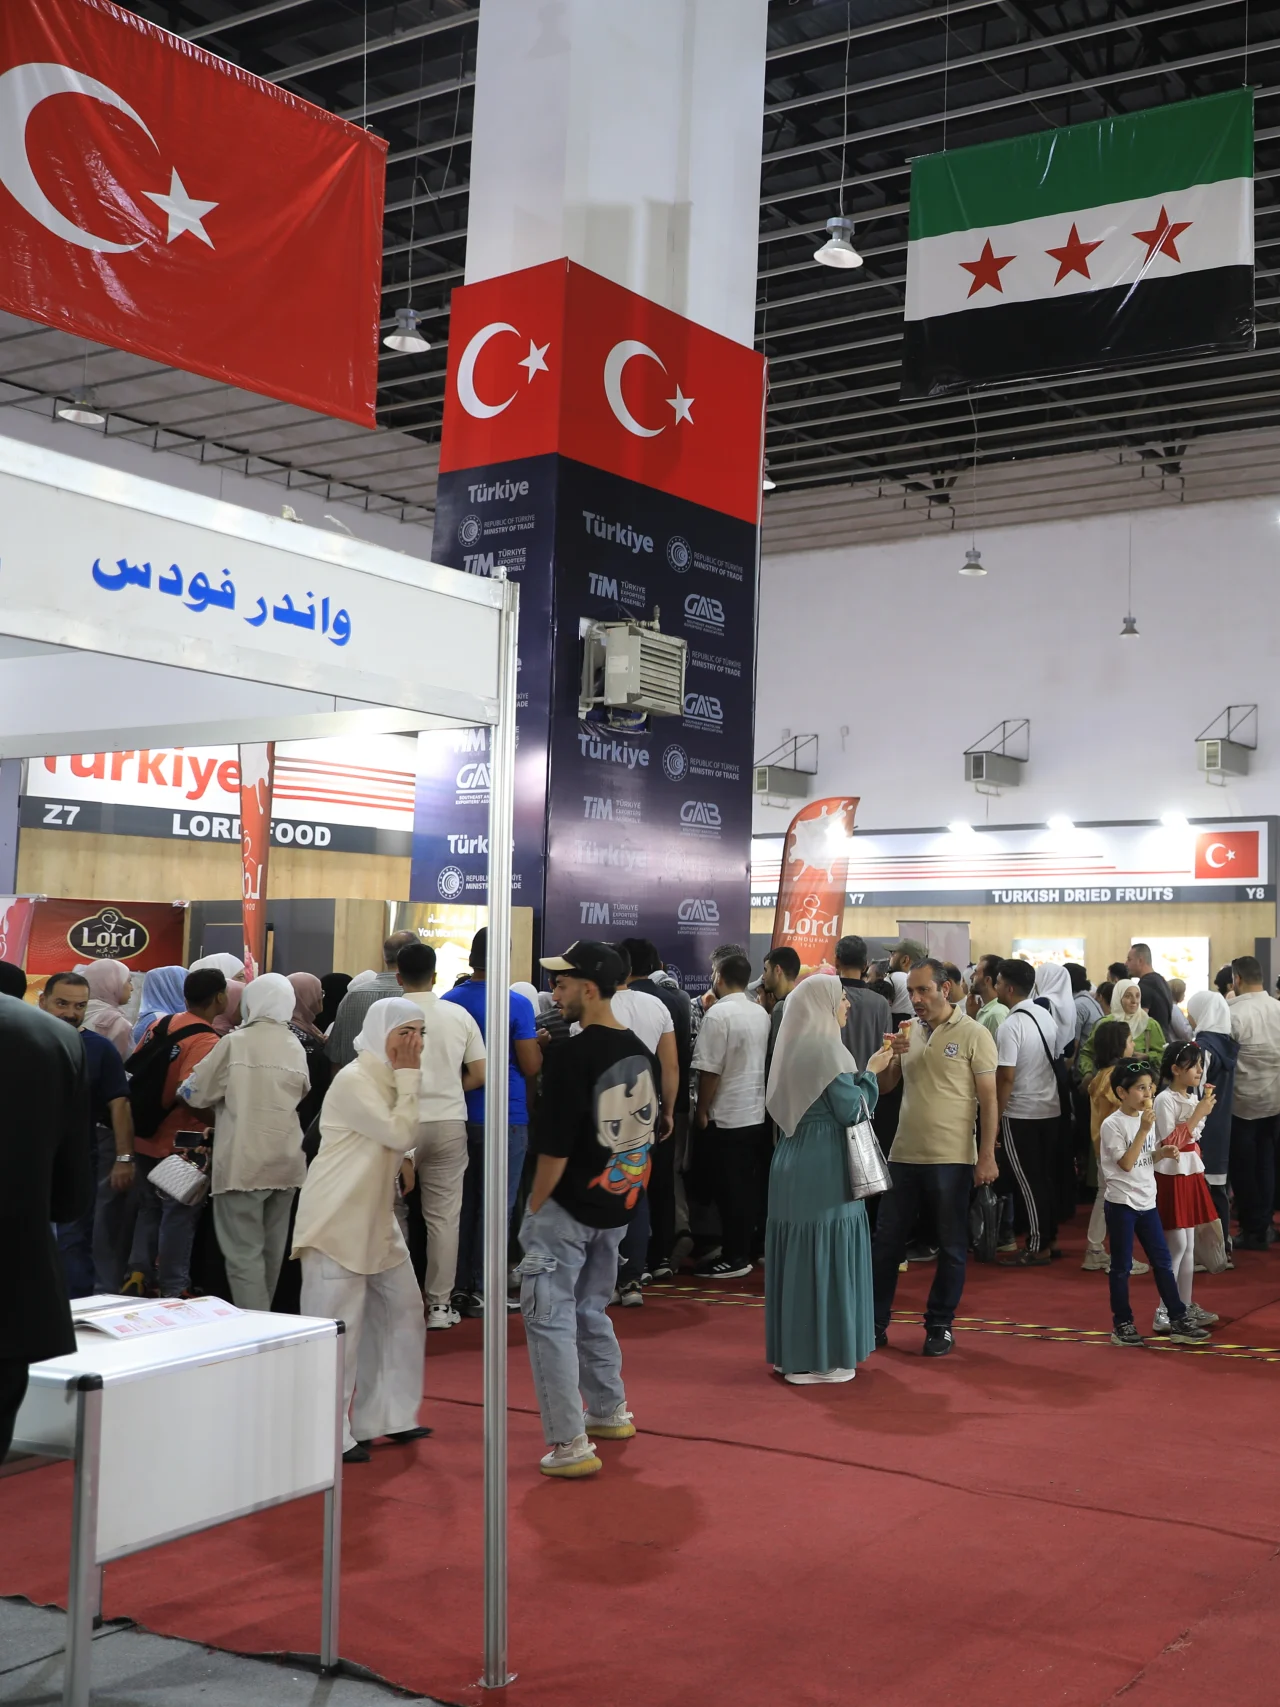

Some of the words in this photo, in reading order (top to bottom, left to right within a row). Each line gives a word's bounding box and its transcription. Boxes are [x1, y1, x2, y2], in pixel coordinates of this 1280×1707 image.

[468, 480, 529, 503] Türkiye
[484, 519, 507, 527] REPUBLIC
[507, 517, 515, 525] OF
[484, 526, 508, 535] MINISTRY
[517, 522, 535, 530] TRADE
[583, 510, 654, 553] Türkiye
[498, 557, 526, 565] EXPORTERS
[694, 552, 716, 564] REPUBLIC
[717, 559, 724, 567] OF
[694, 560, 718, 574] MINISTRY
[718, 568, 726, 576] OF
[726, 571, 743, 581] TRADE
[92, 557, 236, 613] فودس
[243, 591, 351, 646] واندر
[692, 651, 714, 662] REPUBLIC
[715, 656, 722, 664] OF
[692, 659, 716, 671] MINISTRY
[717, 665, 723, 673] OF
[724, 667, 741, 677] TRADE
[578, 733, 650, 770] Türkiye
[690, 757, 713, 768] REPUBLIC
[713, 761, 720, 769] OF
[690, 766, 714, 777] MINISTRY
[715, 770, 722, 778] OF
[723, 771, 739, 780] TRADE
[43, 804, 81, 825] Z7
[269, 826, 332, 846] OOD
[762, 896, 771, 906] OF
[849, 893, 865, 905] Y7
[992, 889, 1060, 903] TURKISH
[1064, 888, 1111, 902] DRIED
[1116, 887, 1174, 901] FRUITS
[1245, 887, 1265, 900] Y8
[782, 911, 838, 936] Lord
[81, 926, 136, 948] Lord
[418, 928, 434, 937] You
[684, 974, 708, 982] REPUBLIC
[684, 983, 709, 991] MINISTRY
